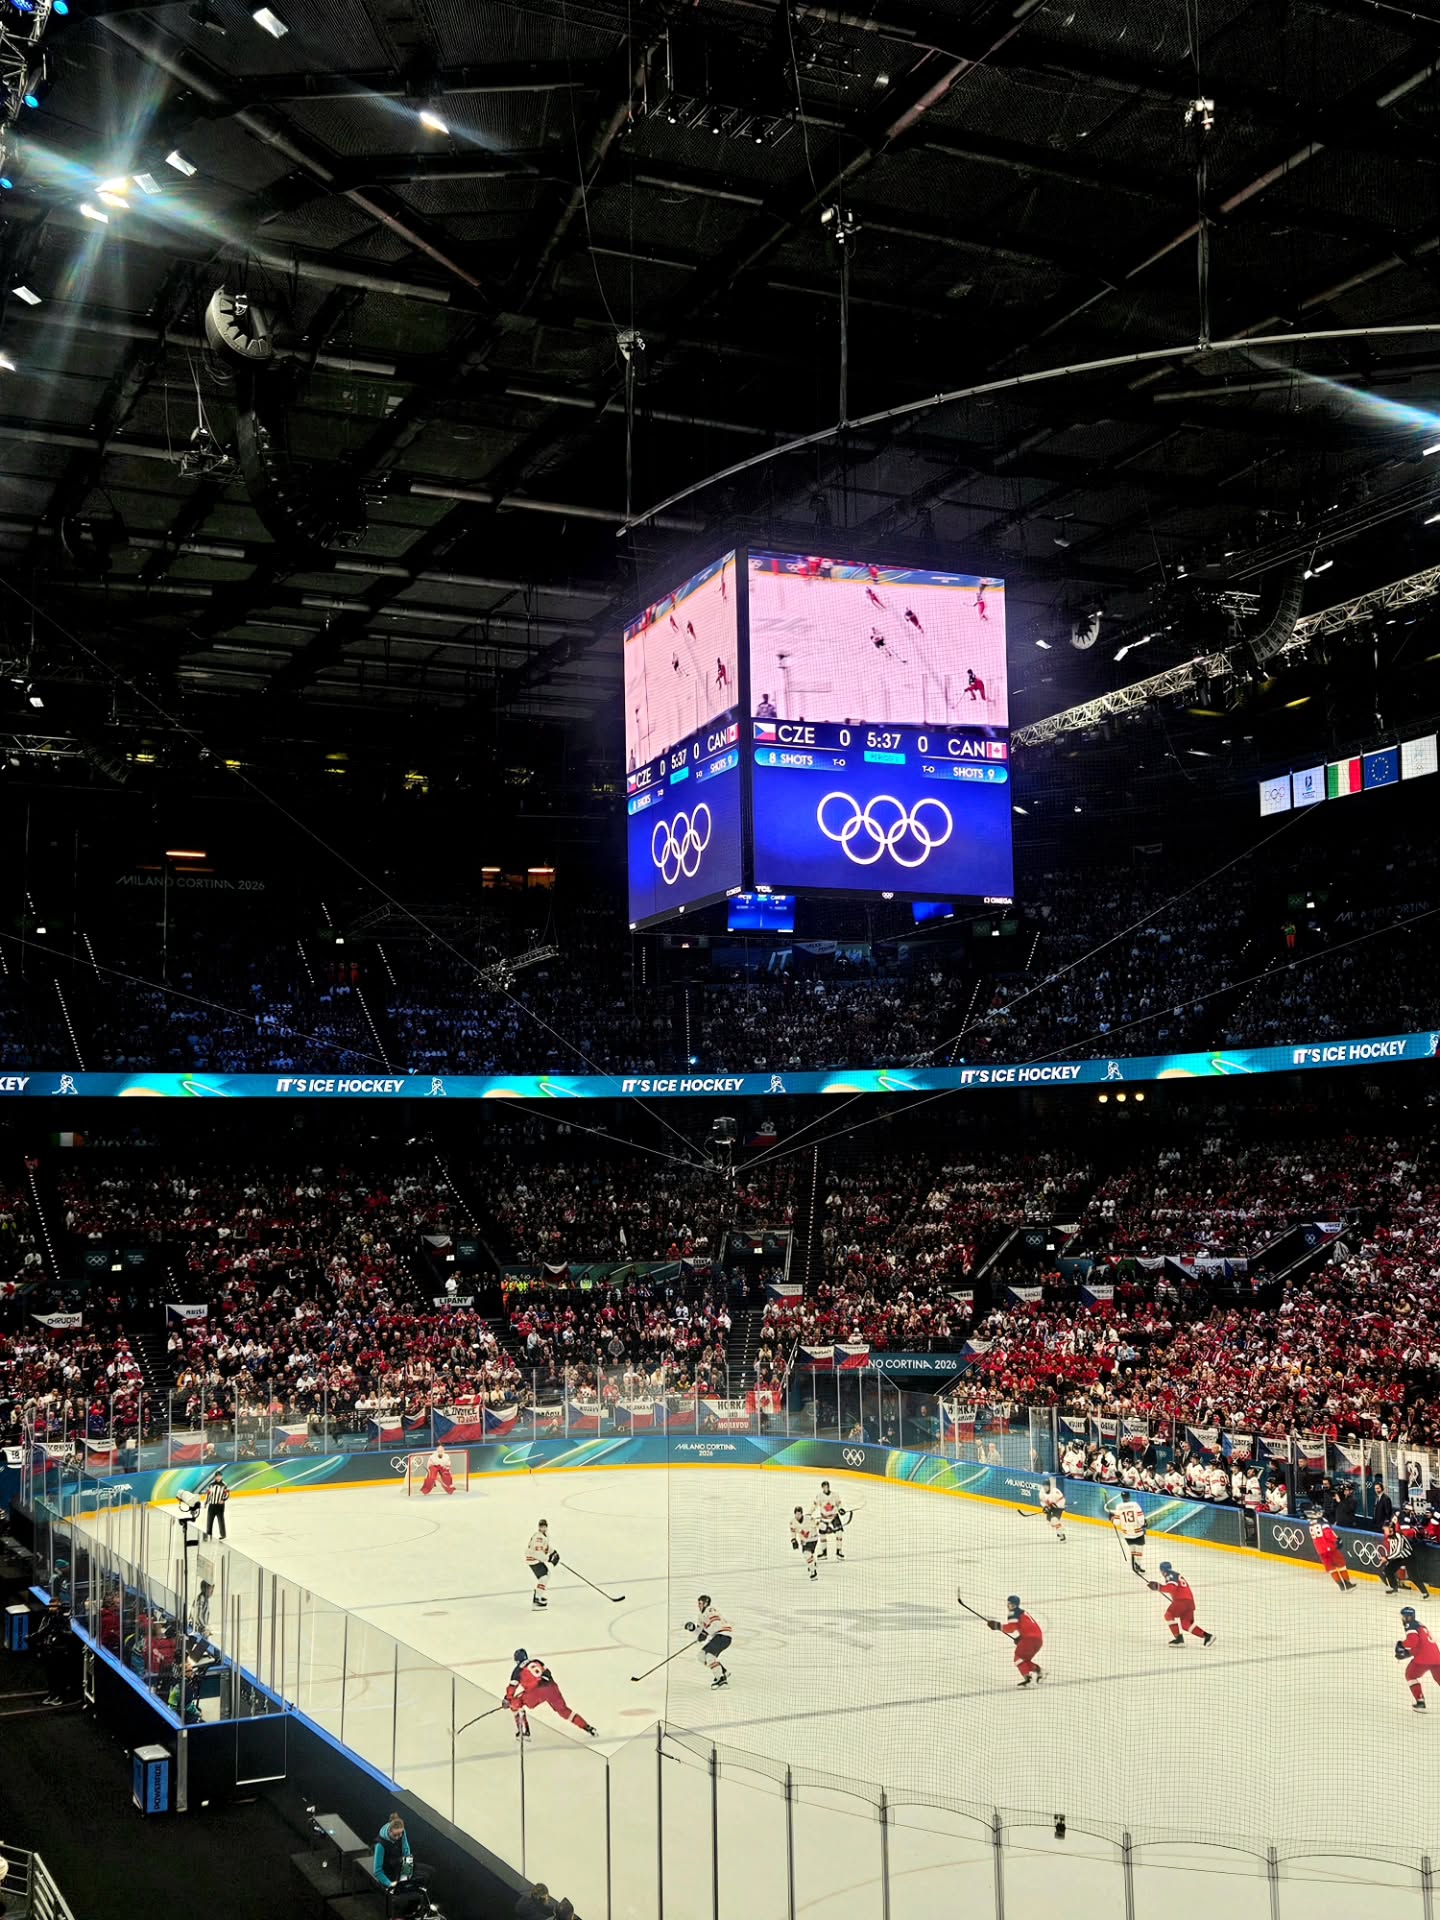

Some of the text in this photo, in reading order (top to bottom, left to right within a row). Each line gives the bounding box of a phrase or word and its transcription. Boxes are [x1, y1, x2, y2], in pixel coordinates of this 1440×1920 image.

[707, 729, 728, 752] CAN
[778, 725, 986, 758] CZE 0 5:37 0 CAN
[671, 748, 687, 770] 5:37
[694, 742, 700, 760] 0
[768, 752, 813, 766] 8 SHOTS
[660, 760, 666, 776] 0
[953, 766, 984, 778] SHOTS
[636, 767, 652, 788] CZE
[238, 880, 265, 890] 2026
[1322, 1046, 1346, 1062] ICE
[1349, 1040, 1407, 1060] HOCKEY
[991, 1068, 1017, 1082] ICE
[1018, 1065, 1081, 1082] HOCKEY
[308, 1079, 336, 1092] ICE
[338, 1080, 405, 1092] HOCKEY
[652, 1079, 678, 1092] ICE
[680, 1078, 744, 1092] HOCKEY
[886, 1360, 933, 1370] CORTINA
[934, 1360, 957, 1370] 2026
[1122, 1510, 1135, 1524] 13
